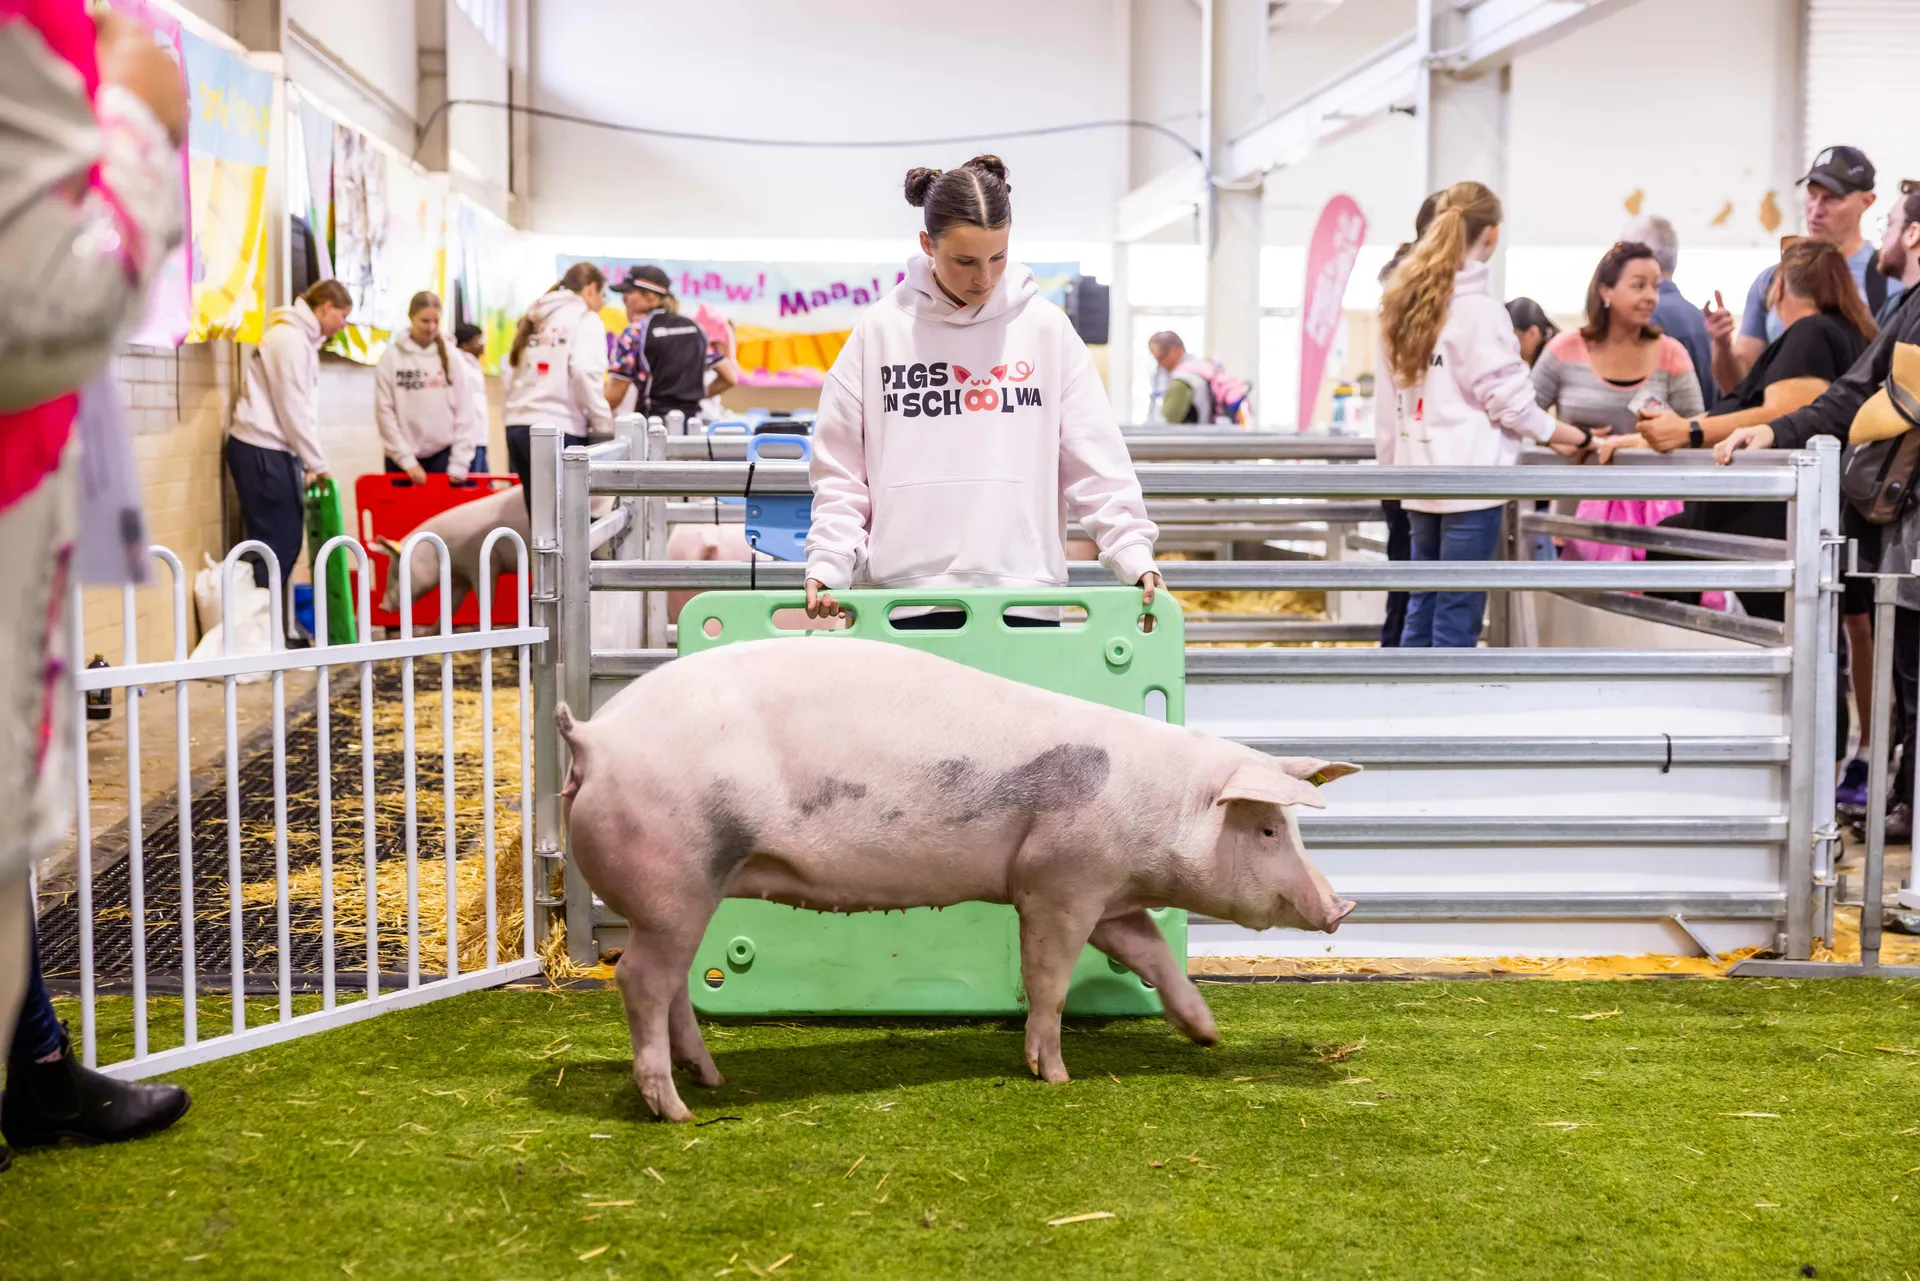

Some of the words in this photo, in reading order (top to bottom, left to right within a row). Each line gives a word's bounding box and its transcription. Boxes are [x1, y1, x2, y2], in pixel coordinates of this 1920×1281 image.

[881, 362, 949, 391] PIGS
[884, 393, 898, 413] IN
[902, 388, 1015, 418] SCHOOL
[1015, 387, 1042, 406] WA
